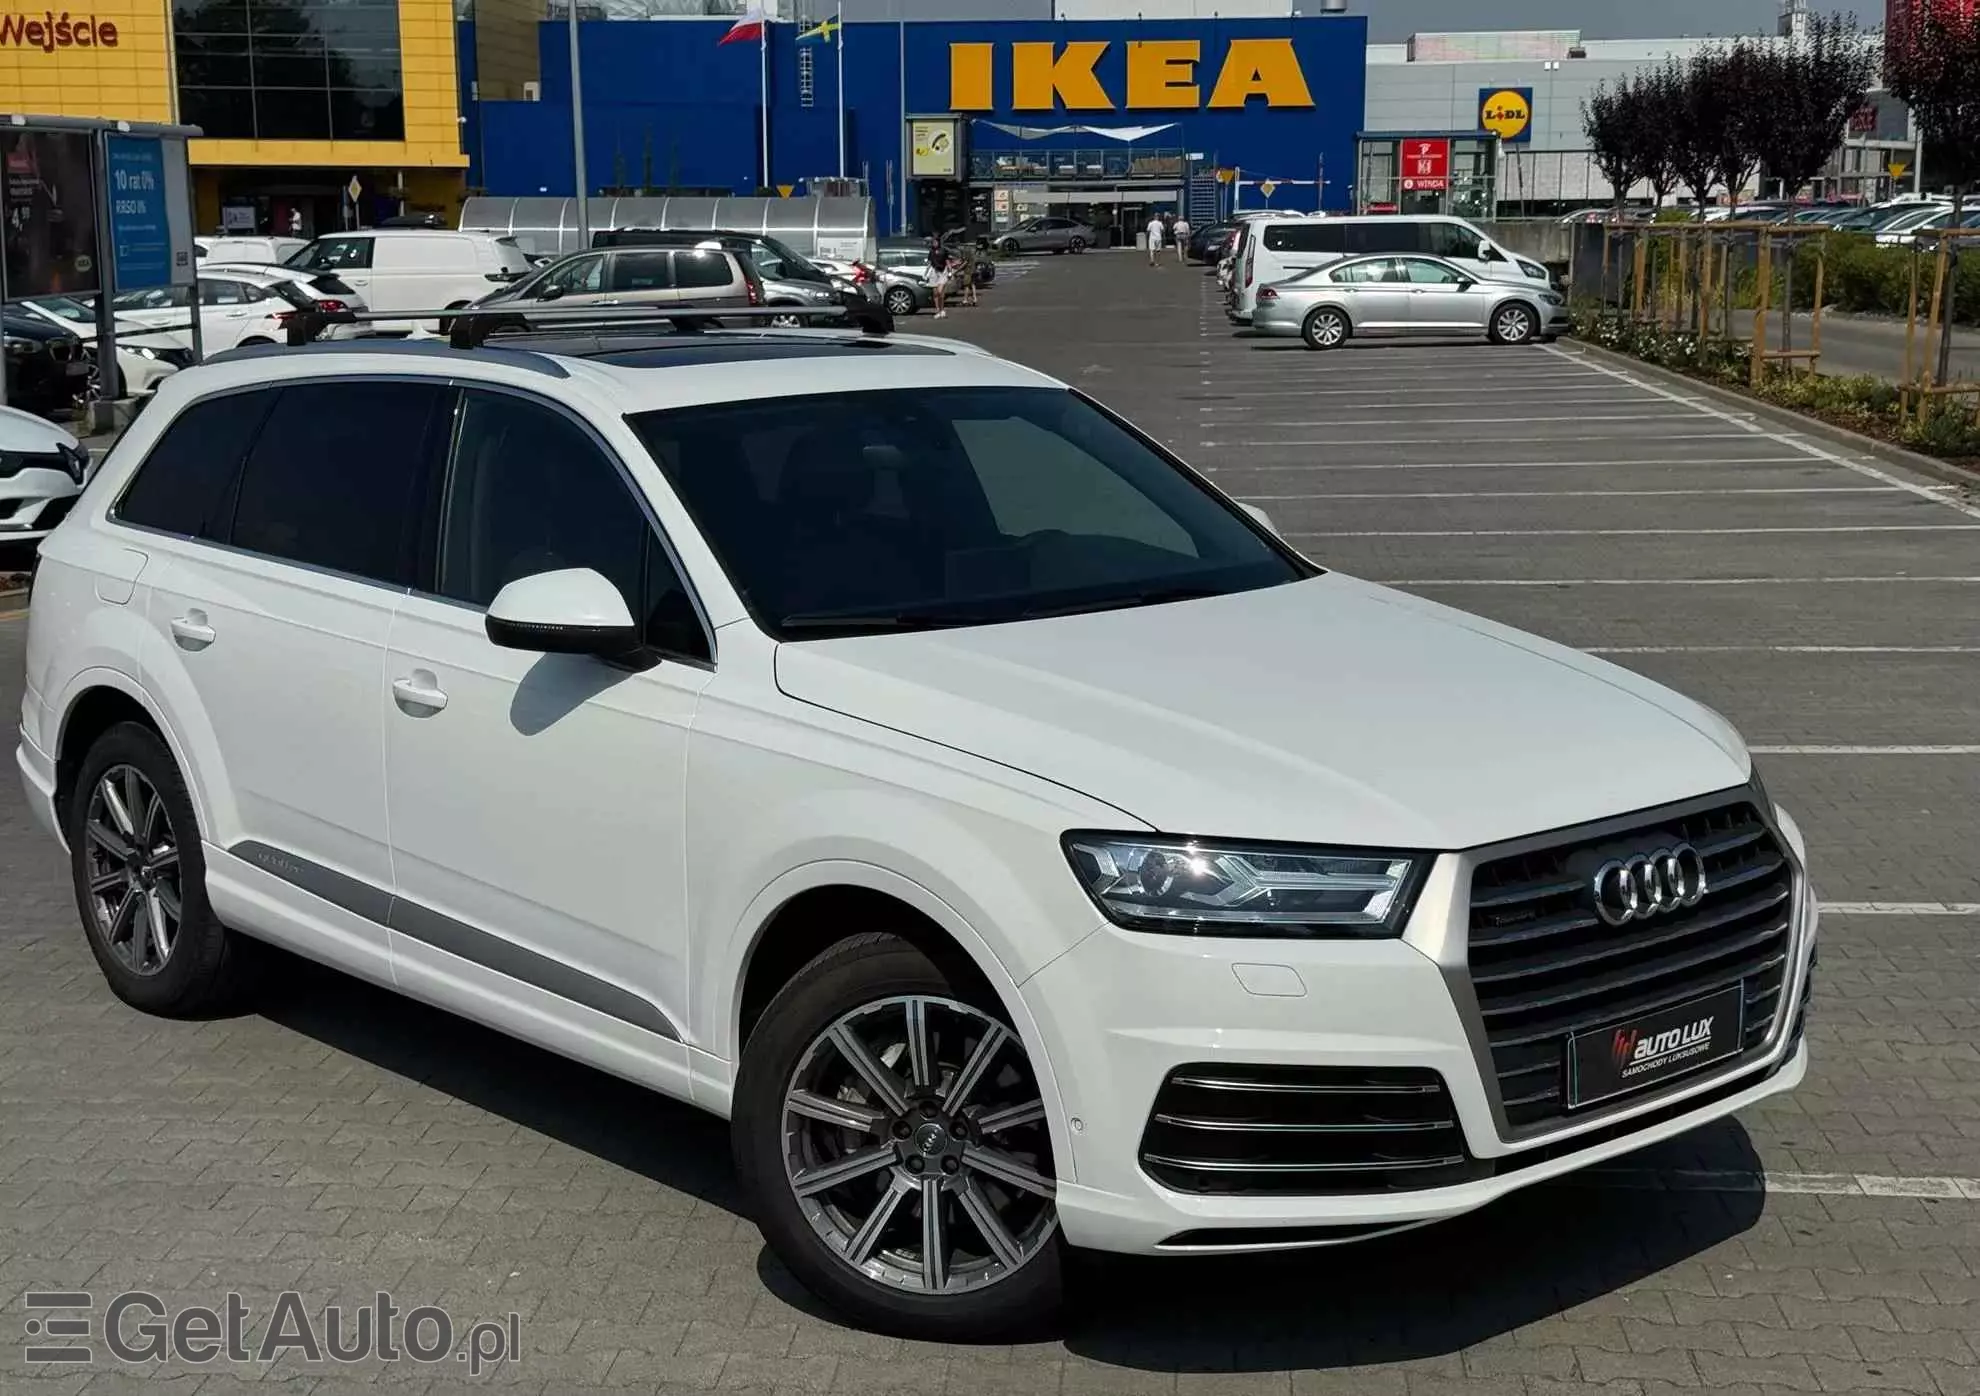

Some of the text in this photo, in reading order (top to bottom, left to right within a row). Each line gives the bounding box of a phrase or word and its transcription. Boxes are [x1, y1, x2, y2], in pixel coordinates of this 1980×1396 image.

[0, 10, 119, 54] Wejście
[949, 39, 1316, 110] IKEA
[115, 168, 128, 191] 10
[128, 174, 141, 191] rat
[1682, 1016, 1714, 1044] LUX
[1621, 1042, 1711, 1078] SAMOCHODY LUKSUSOWE
